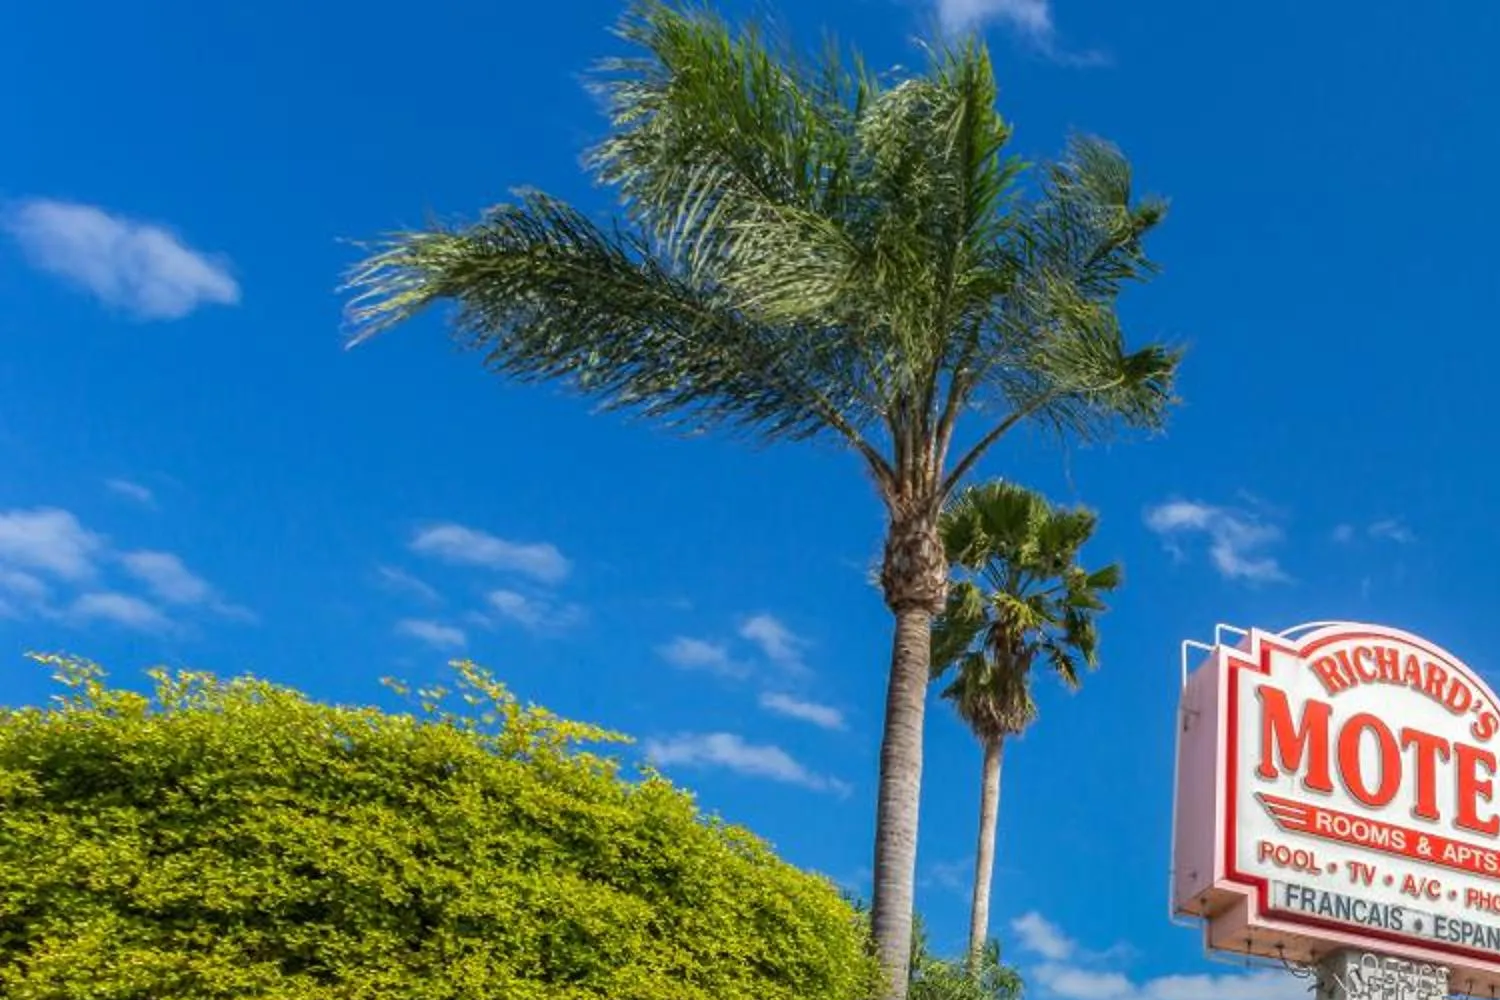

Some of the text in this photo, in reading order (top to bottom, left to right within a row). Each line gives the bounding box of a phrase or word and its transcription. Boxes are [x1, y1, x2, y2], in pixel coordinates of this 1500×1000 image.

[1310, 646, 1499, 741] RICHARD'S
[1315, 810, 1406, 849] ROOMS
[1416, 836, 1433, 857] &
[1257, 840, 1322, 876] POOL
[1347, 860, 1376, 887] TV
[1400, 872, 1442, 899] A/C
[1286, 883, 1403, 931] FRANCAIS
